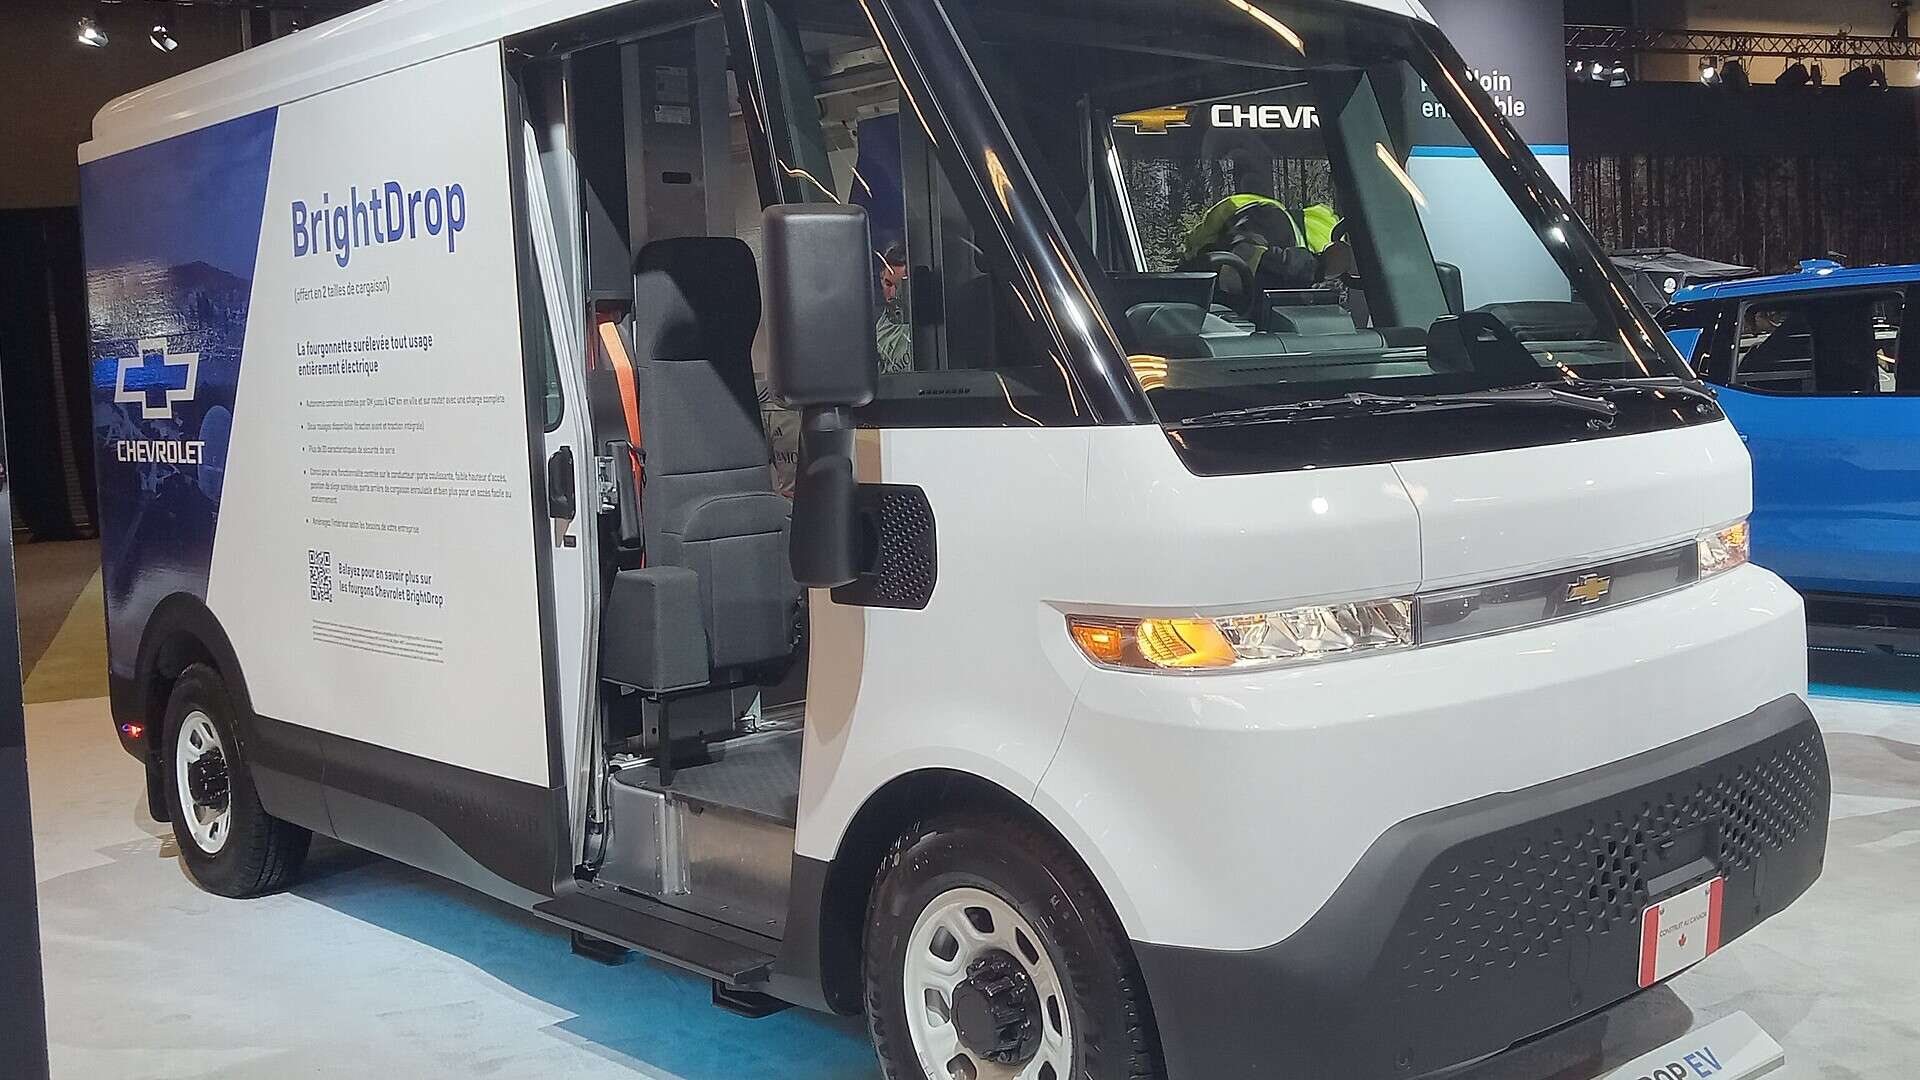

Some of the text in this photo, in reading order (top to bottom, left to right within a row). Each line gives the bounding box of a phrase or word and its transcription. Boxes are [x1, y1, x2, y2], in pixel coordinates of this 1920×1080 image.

[291, 181, 466, 268] BrightDrop
[294, 276, 390, 303] (offert en 2 tailles de cargaison)
[297, 334, 433, 358] La fourgonnette surélevée tout usage
[298, 358, 379, 377] entièrement électrique
[117, 440, 205, 465] CHEVROLET
[339, 562, 432, 586] Balayez pour en savoir plus sur
[339, 580, 444, 609] les fourgons Chevrolet BrightDrop
[1637, 1046, 1722, 1080] OP EV
